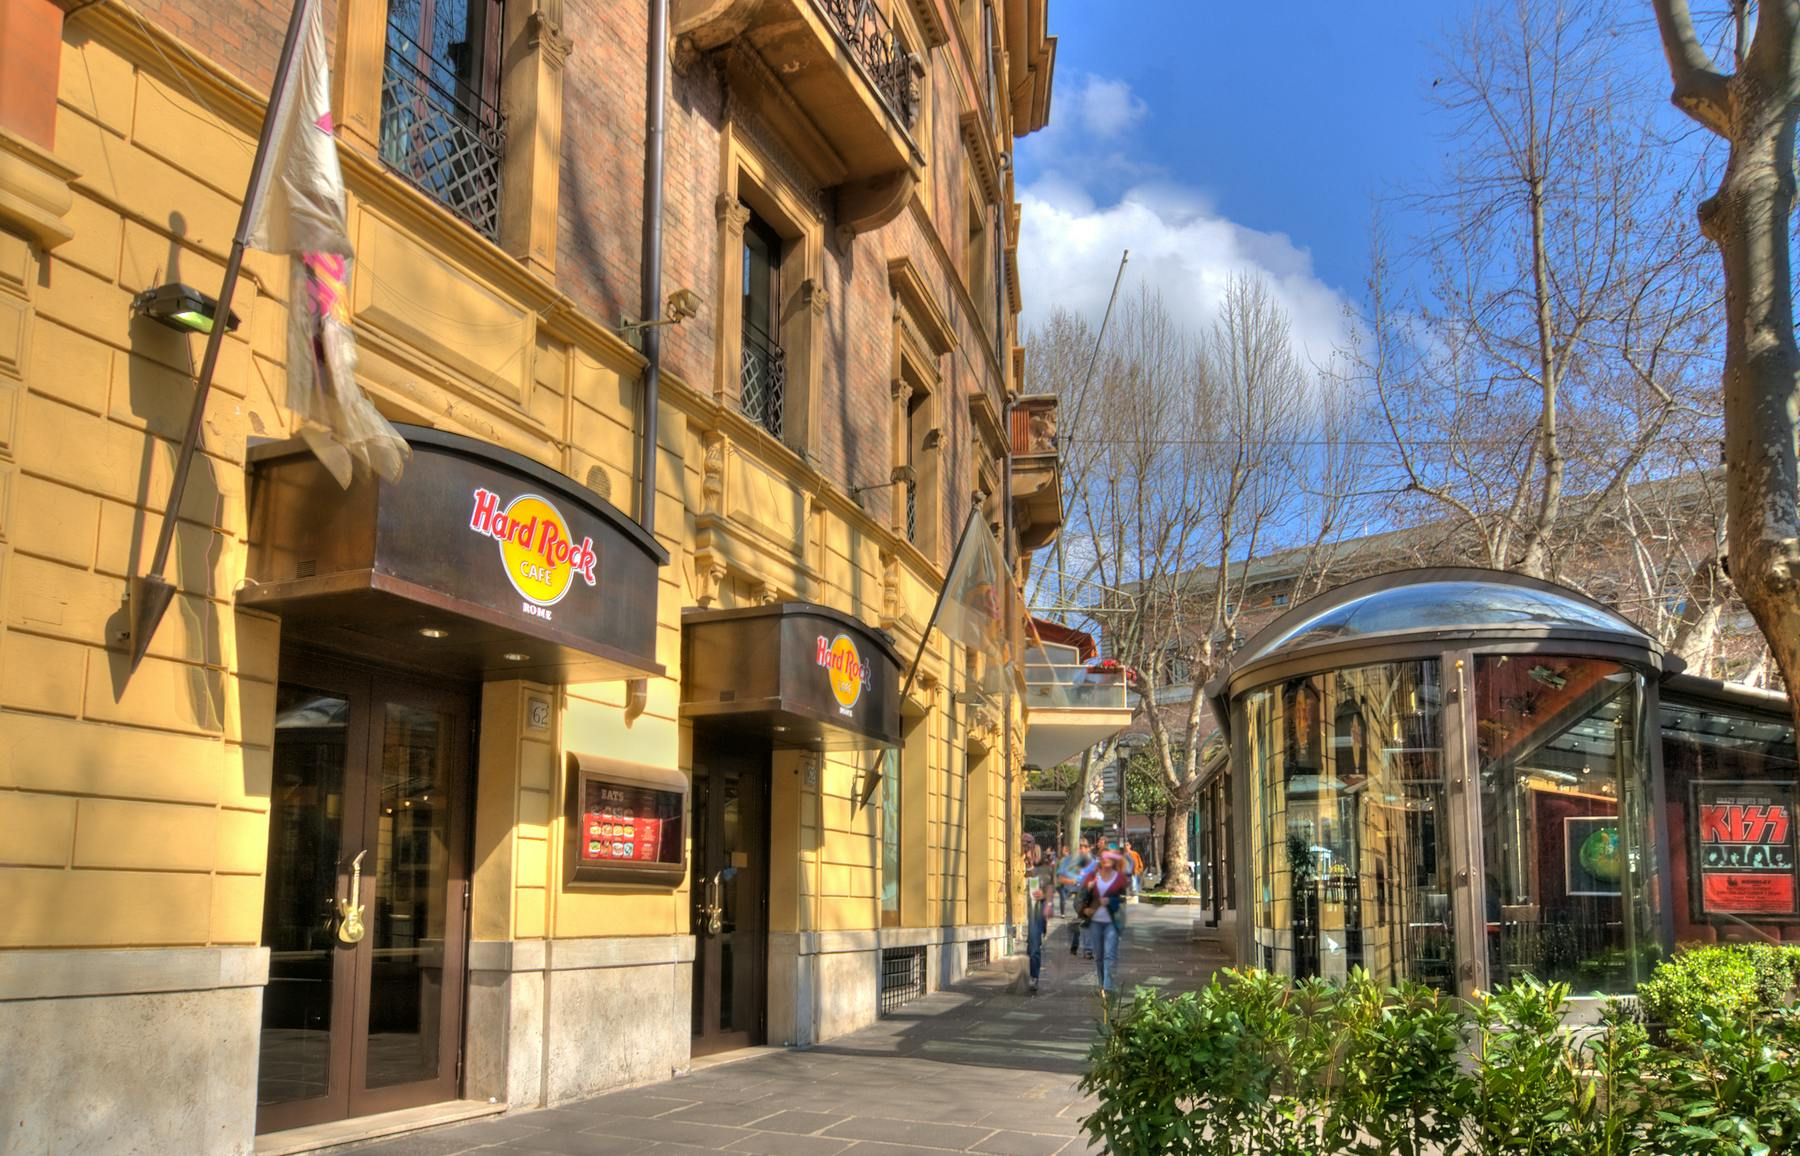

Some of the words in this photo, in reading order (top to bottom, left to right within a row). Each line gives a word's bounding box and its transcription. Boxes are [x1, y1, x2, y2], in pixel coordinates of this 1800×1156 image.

[470, 489, 538, 550] Hard
[538, 519, 598, 586] Rock
[520, 561, 552, 586] CAFE
[523, 602, 552, 621] ROME
[816, 635, 844, 672] Hard
[533, 706, 549, 725] 62
[601, 789, 624, 802] EATS
[1700, 804, 1788, 843] KISS
